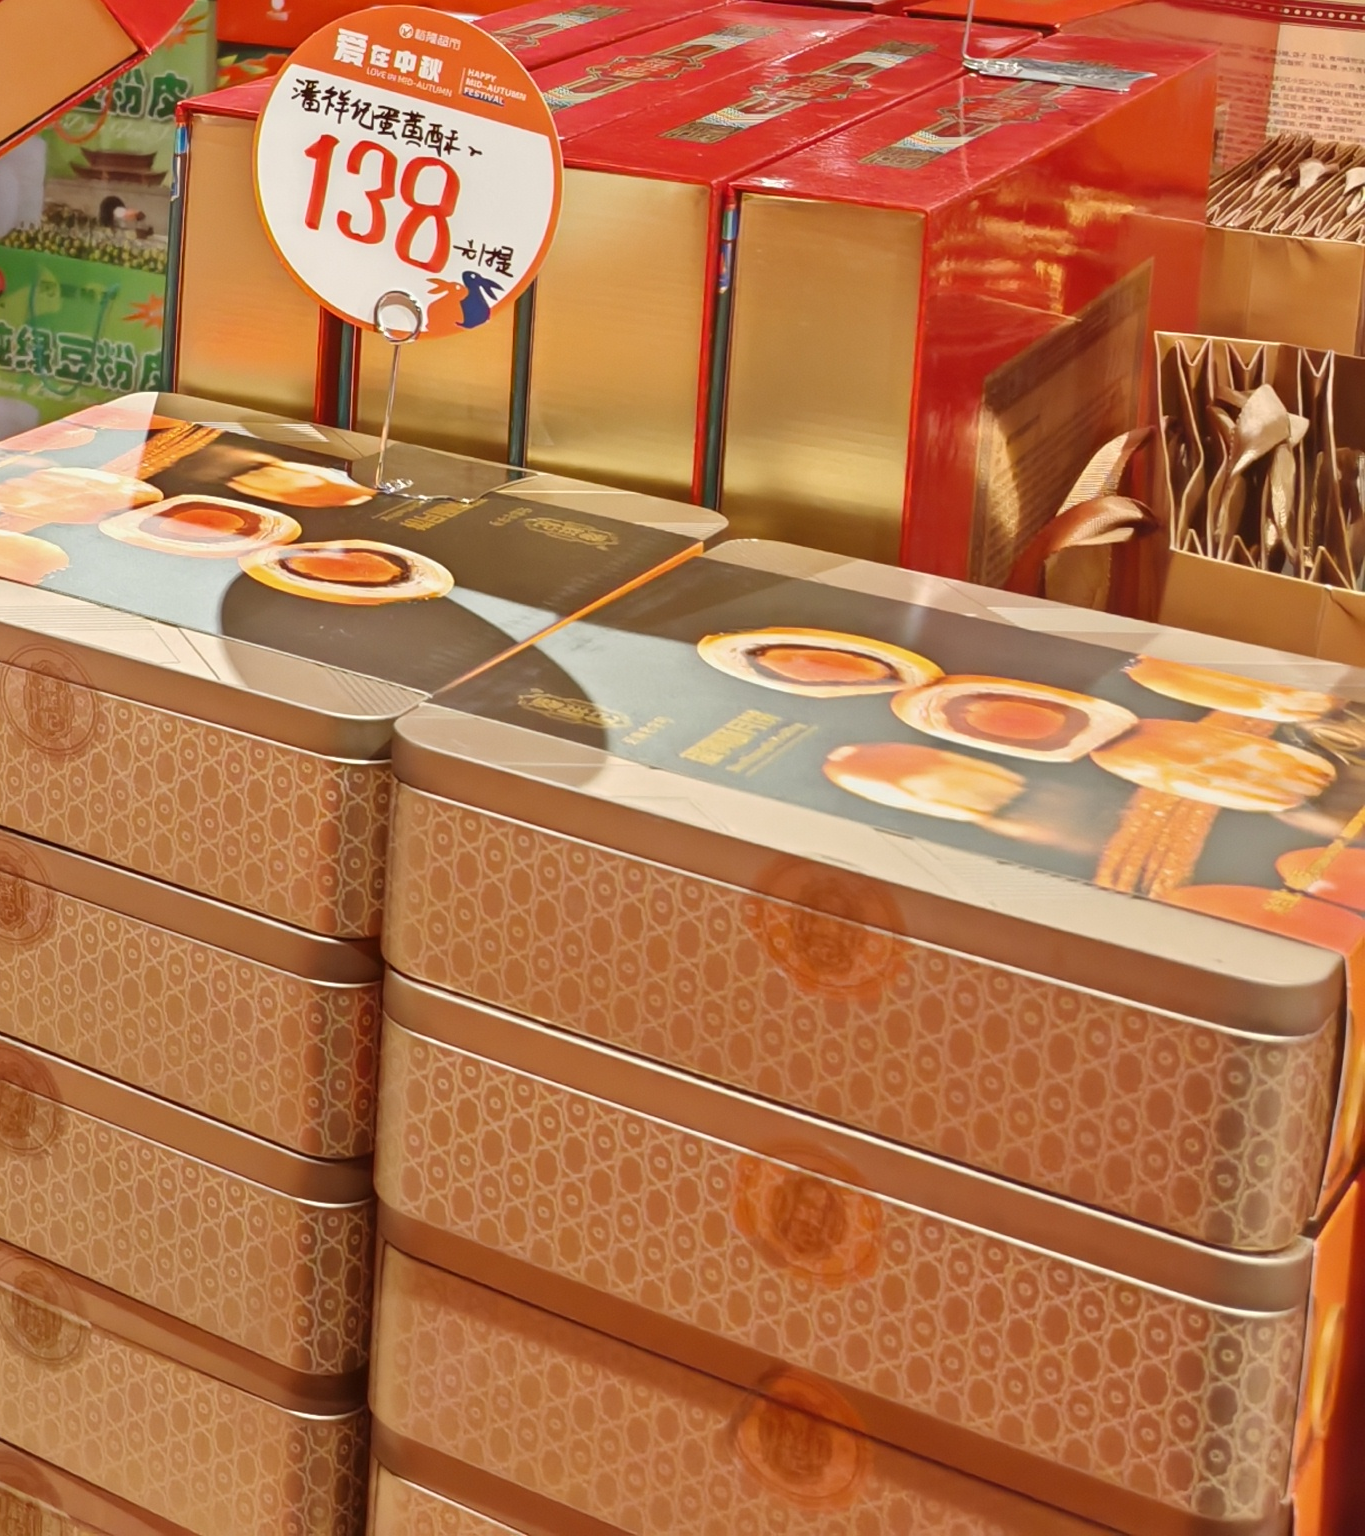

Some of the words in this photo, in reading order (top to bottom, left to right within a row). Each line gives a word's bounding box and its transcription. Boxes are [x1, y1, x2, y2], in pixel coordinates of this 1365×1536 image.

[332, 27, 445, 84] 爱在中秋
[365, 66, 388, 80] LOVE
[396, 74, 454, 98] MID-AUTUMN
[465, 77, 528, 102] MID-AUTUMN
[467, 68, 499, 83] HAPPY
[462, 86, 507, 107] FESTIVAL
[303, 133, 462, 275] 138
